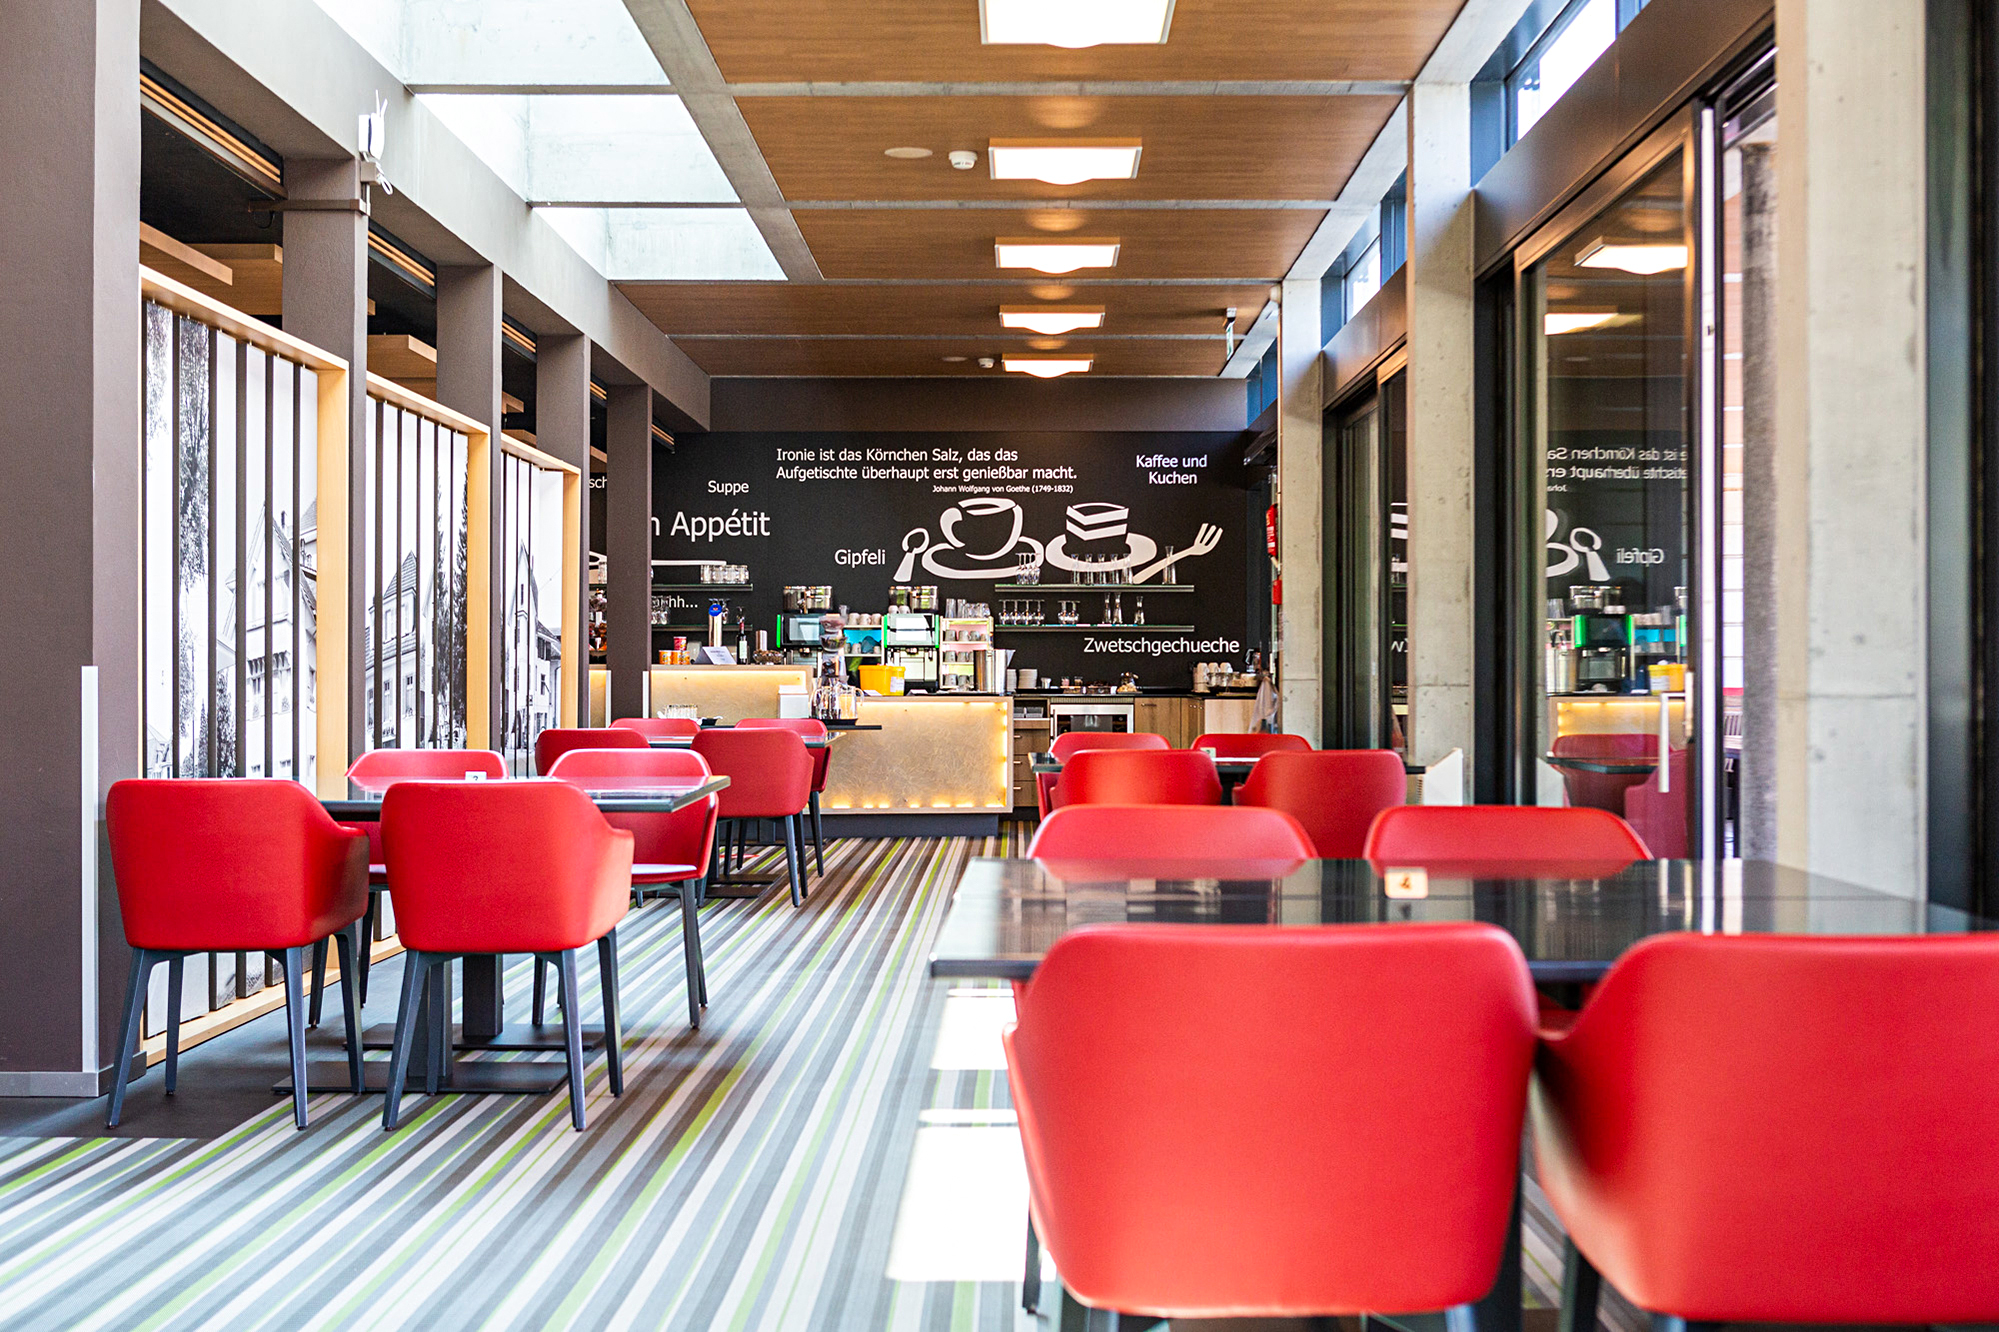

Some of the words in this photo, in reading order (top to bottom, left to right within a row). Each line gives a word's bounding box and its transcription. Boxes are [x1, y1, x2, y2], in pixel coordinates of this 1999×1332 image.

[776, 448, 816, 462] Ironie
[819, 448, 836, 462] ist
[838, 447, 863, 462] das
[866, 447, 928, 462] Körnchen
[931, 447, 963, 464] Salz,
[967, 447, 991, 462] das
[994, 447, 1019, 462] das
[1136, 454, 1179, 468] Kaffee
[1182, 454, 1208, 468] und
[776, 465, 858, 482] Aufgetischte
[861, 465, 930, 482] überhaupt
[932, 466, 960, 480] erst
[962, 465, 1029, 483] genießbar
[1032, 465, 1078, 480] macht.
[1148, 470, 1198, 485] Kuchen
[707, 479, 750, 496] Suppe
[932, 484, 957, 494] Johann
[958, 484, 991, 495] Wolfgang
[992, 485, 1004, 494] von
[1006, 484, 1030, 494] Goethe
[1031, 484, 1074, 495] (1749-1832)
[670, 508, 771, 543] Appétit
[834, 548, 886, 568] Gipfeli
[1083, 636, 1240, 657] Zwetschgechueche
